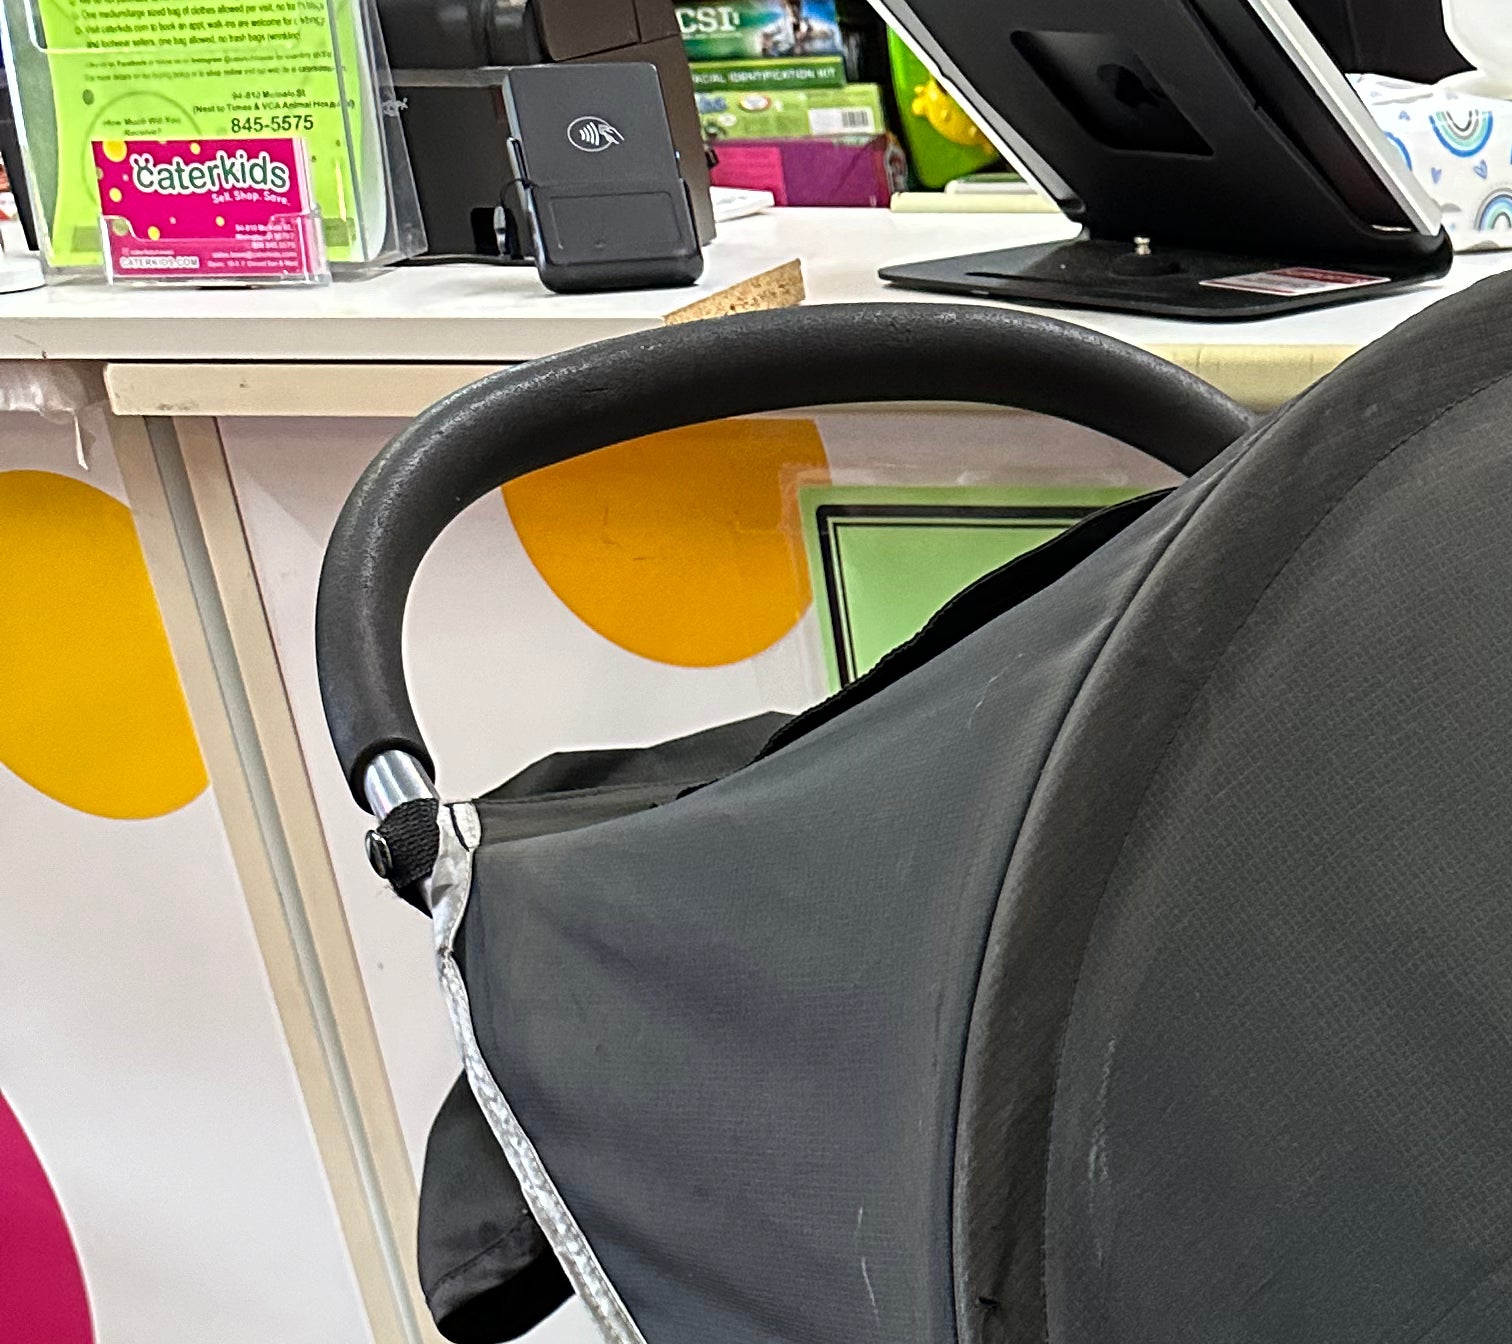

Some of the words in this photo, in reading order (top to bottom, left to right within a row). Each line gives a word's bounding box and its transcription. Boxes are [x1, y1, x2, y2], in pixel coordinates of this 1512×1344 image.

[231, 114, 314, 133] 845-5575
[211, 191, 232, 204] Sell.
[235, 190, 262, 202] Shop.
